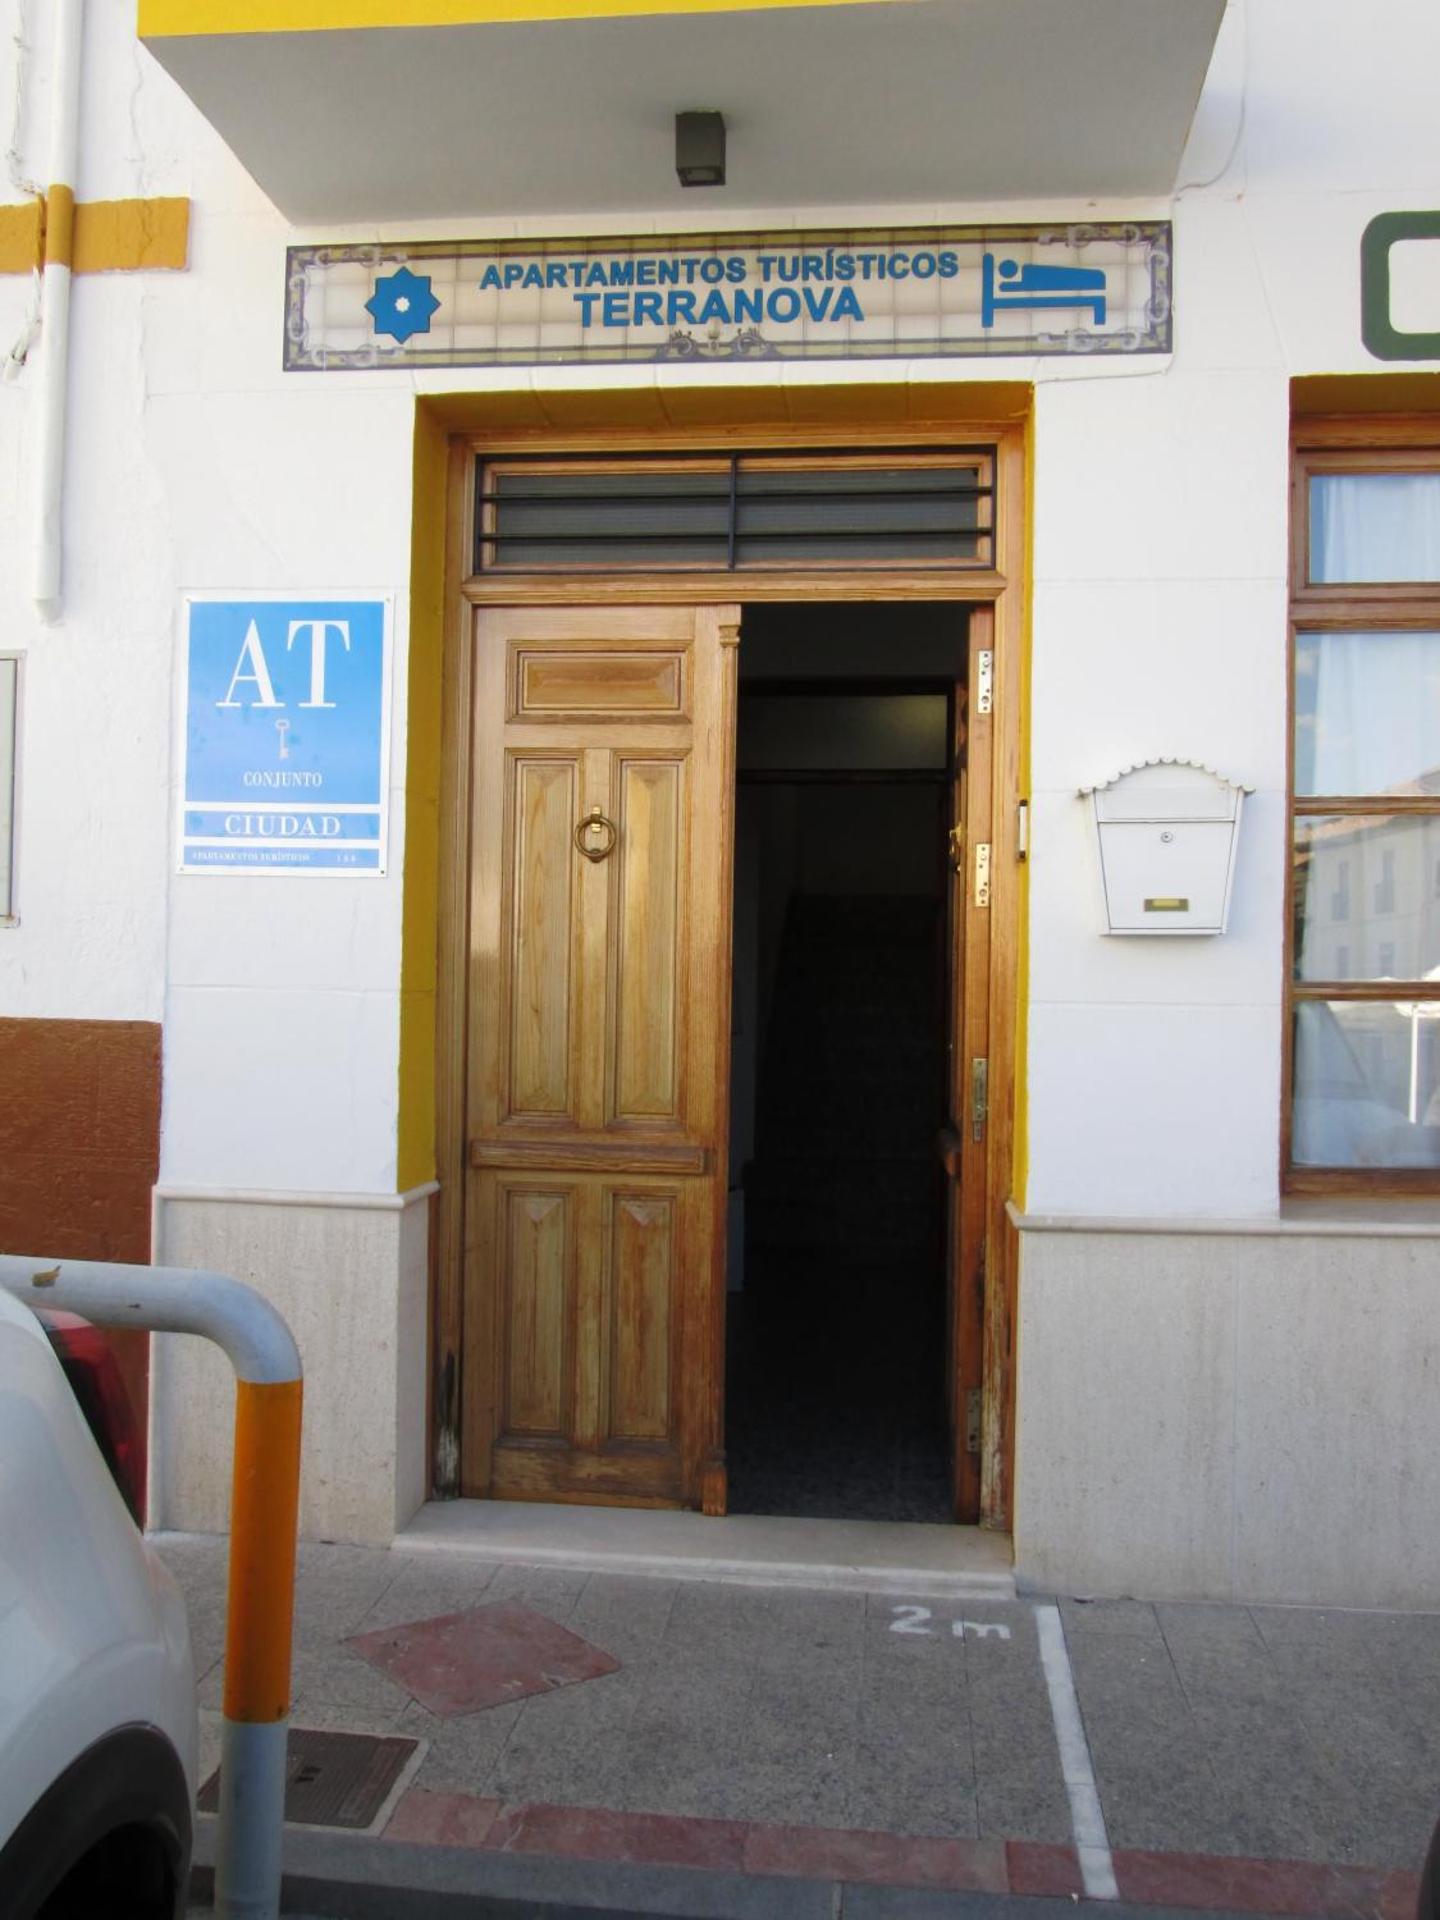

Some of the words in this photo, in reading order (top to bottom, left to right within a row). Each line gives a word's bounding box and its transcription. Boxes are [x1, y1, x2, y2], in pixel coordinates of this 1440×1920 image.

[479, 257, 746, 291] APARTAMENTOS
[757, 250, 959, 283] TURÍSTICOS
[573, 287, 866, 328] TERRANOVA
[215, 617, 351, 708] AT
[243, 770, 323, 788] CONJUNTO
[224, 814, 342, 837] CIUDAD
[889, 1604, 932, 1635] 2
[951, 1620, 1012, 1640] m
